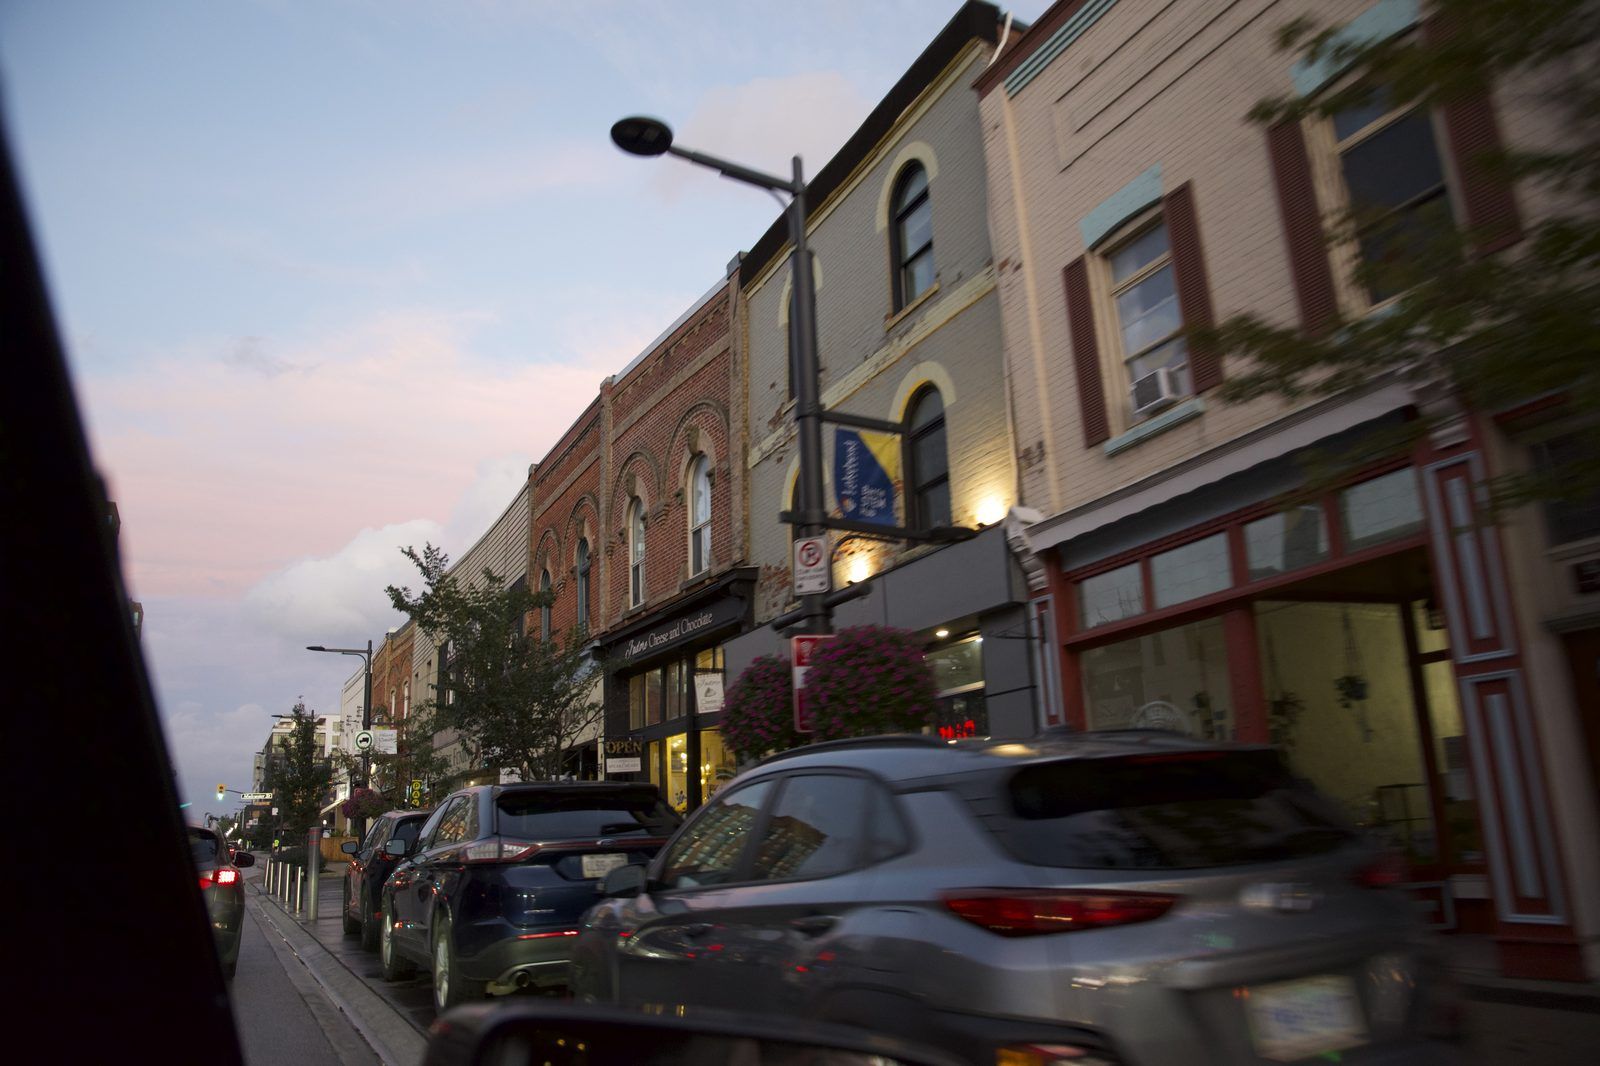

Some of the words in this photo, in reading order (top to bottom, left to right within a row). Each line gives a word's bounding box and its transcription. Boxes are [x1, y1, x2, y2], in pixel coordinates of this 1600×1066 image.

[648, 632, 669, 648] Cheese
[669, 624, 680, 640] and
[680, 612, 713, 634] Chocolate
[605, 740, 642, 753] OPEN
